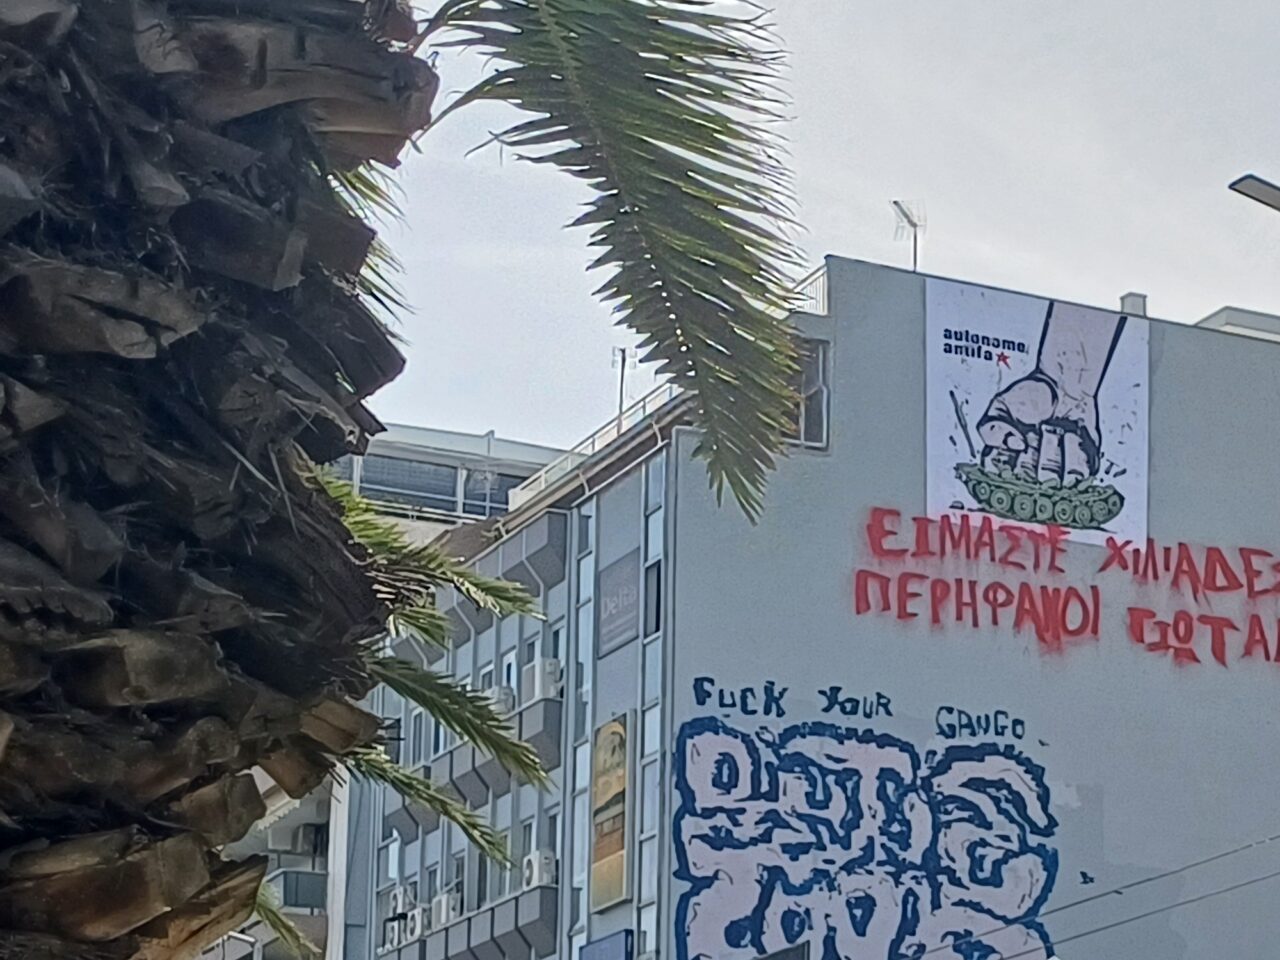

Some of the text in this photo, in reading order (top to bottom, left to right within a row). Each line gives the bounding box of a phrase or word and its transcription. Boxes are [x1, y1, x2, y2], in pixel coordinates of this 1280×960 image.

[943, 342, 993, 361] antifa
[866, 506, 1071, 573] ΕΙΜΑΣΤΕ
[855, 569, 1100, 643] ΠΕΡΗΦΑΝΟΙ
[693, 677, 788, 717] FUCK
